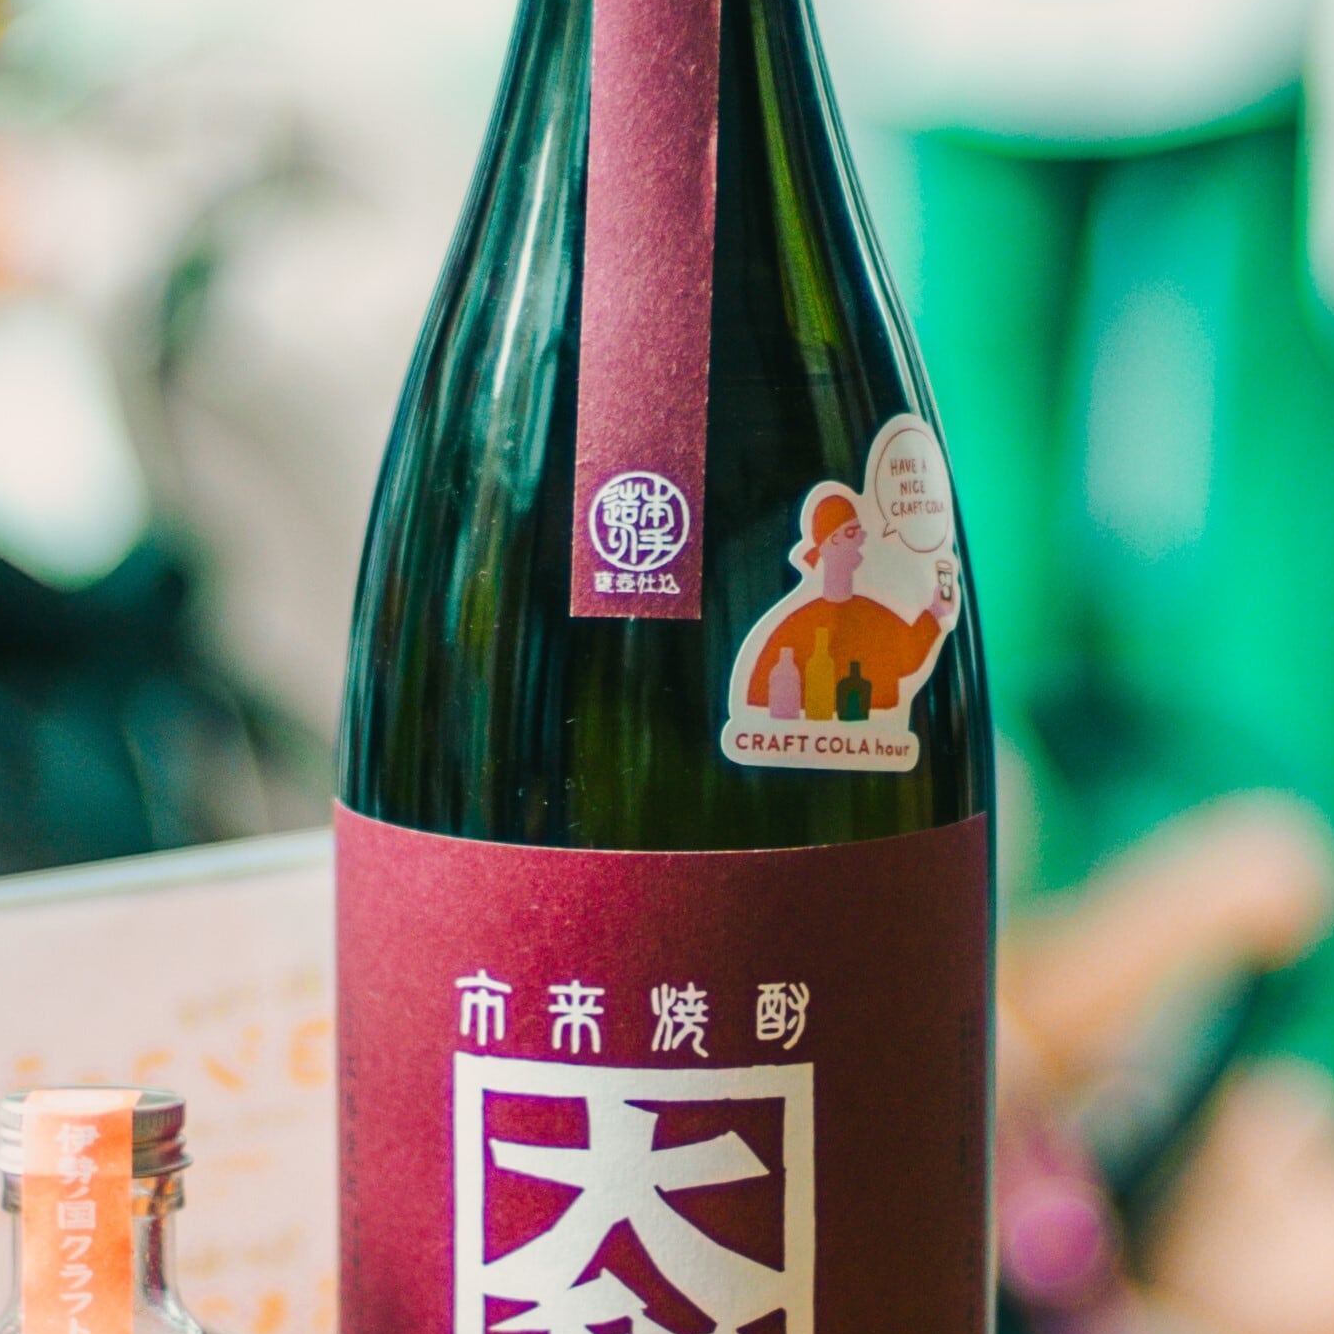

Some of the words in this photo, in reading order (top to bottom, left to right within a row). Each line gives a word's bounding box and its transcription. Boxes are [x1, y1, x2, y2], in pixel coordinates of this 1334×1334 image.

[890, 458, 917, 477] HAVE
[900, 480, 926, 496] NICE
[890, 500, 923, 517] CRAFT
[734, 732, 809, 753] CRAFT
[814, 736, 870, 755] COLA
[874, 738, 910, 757] hour
